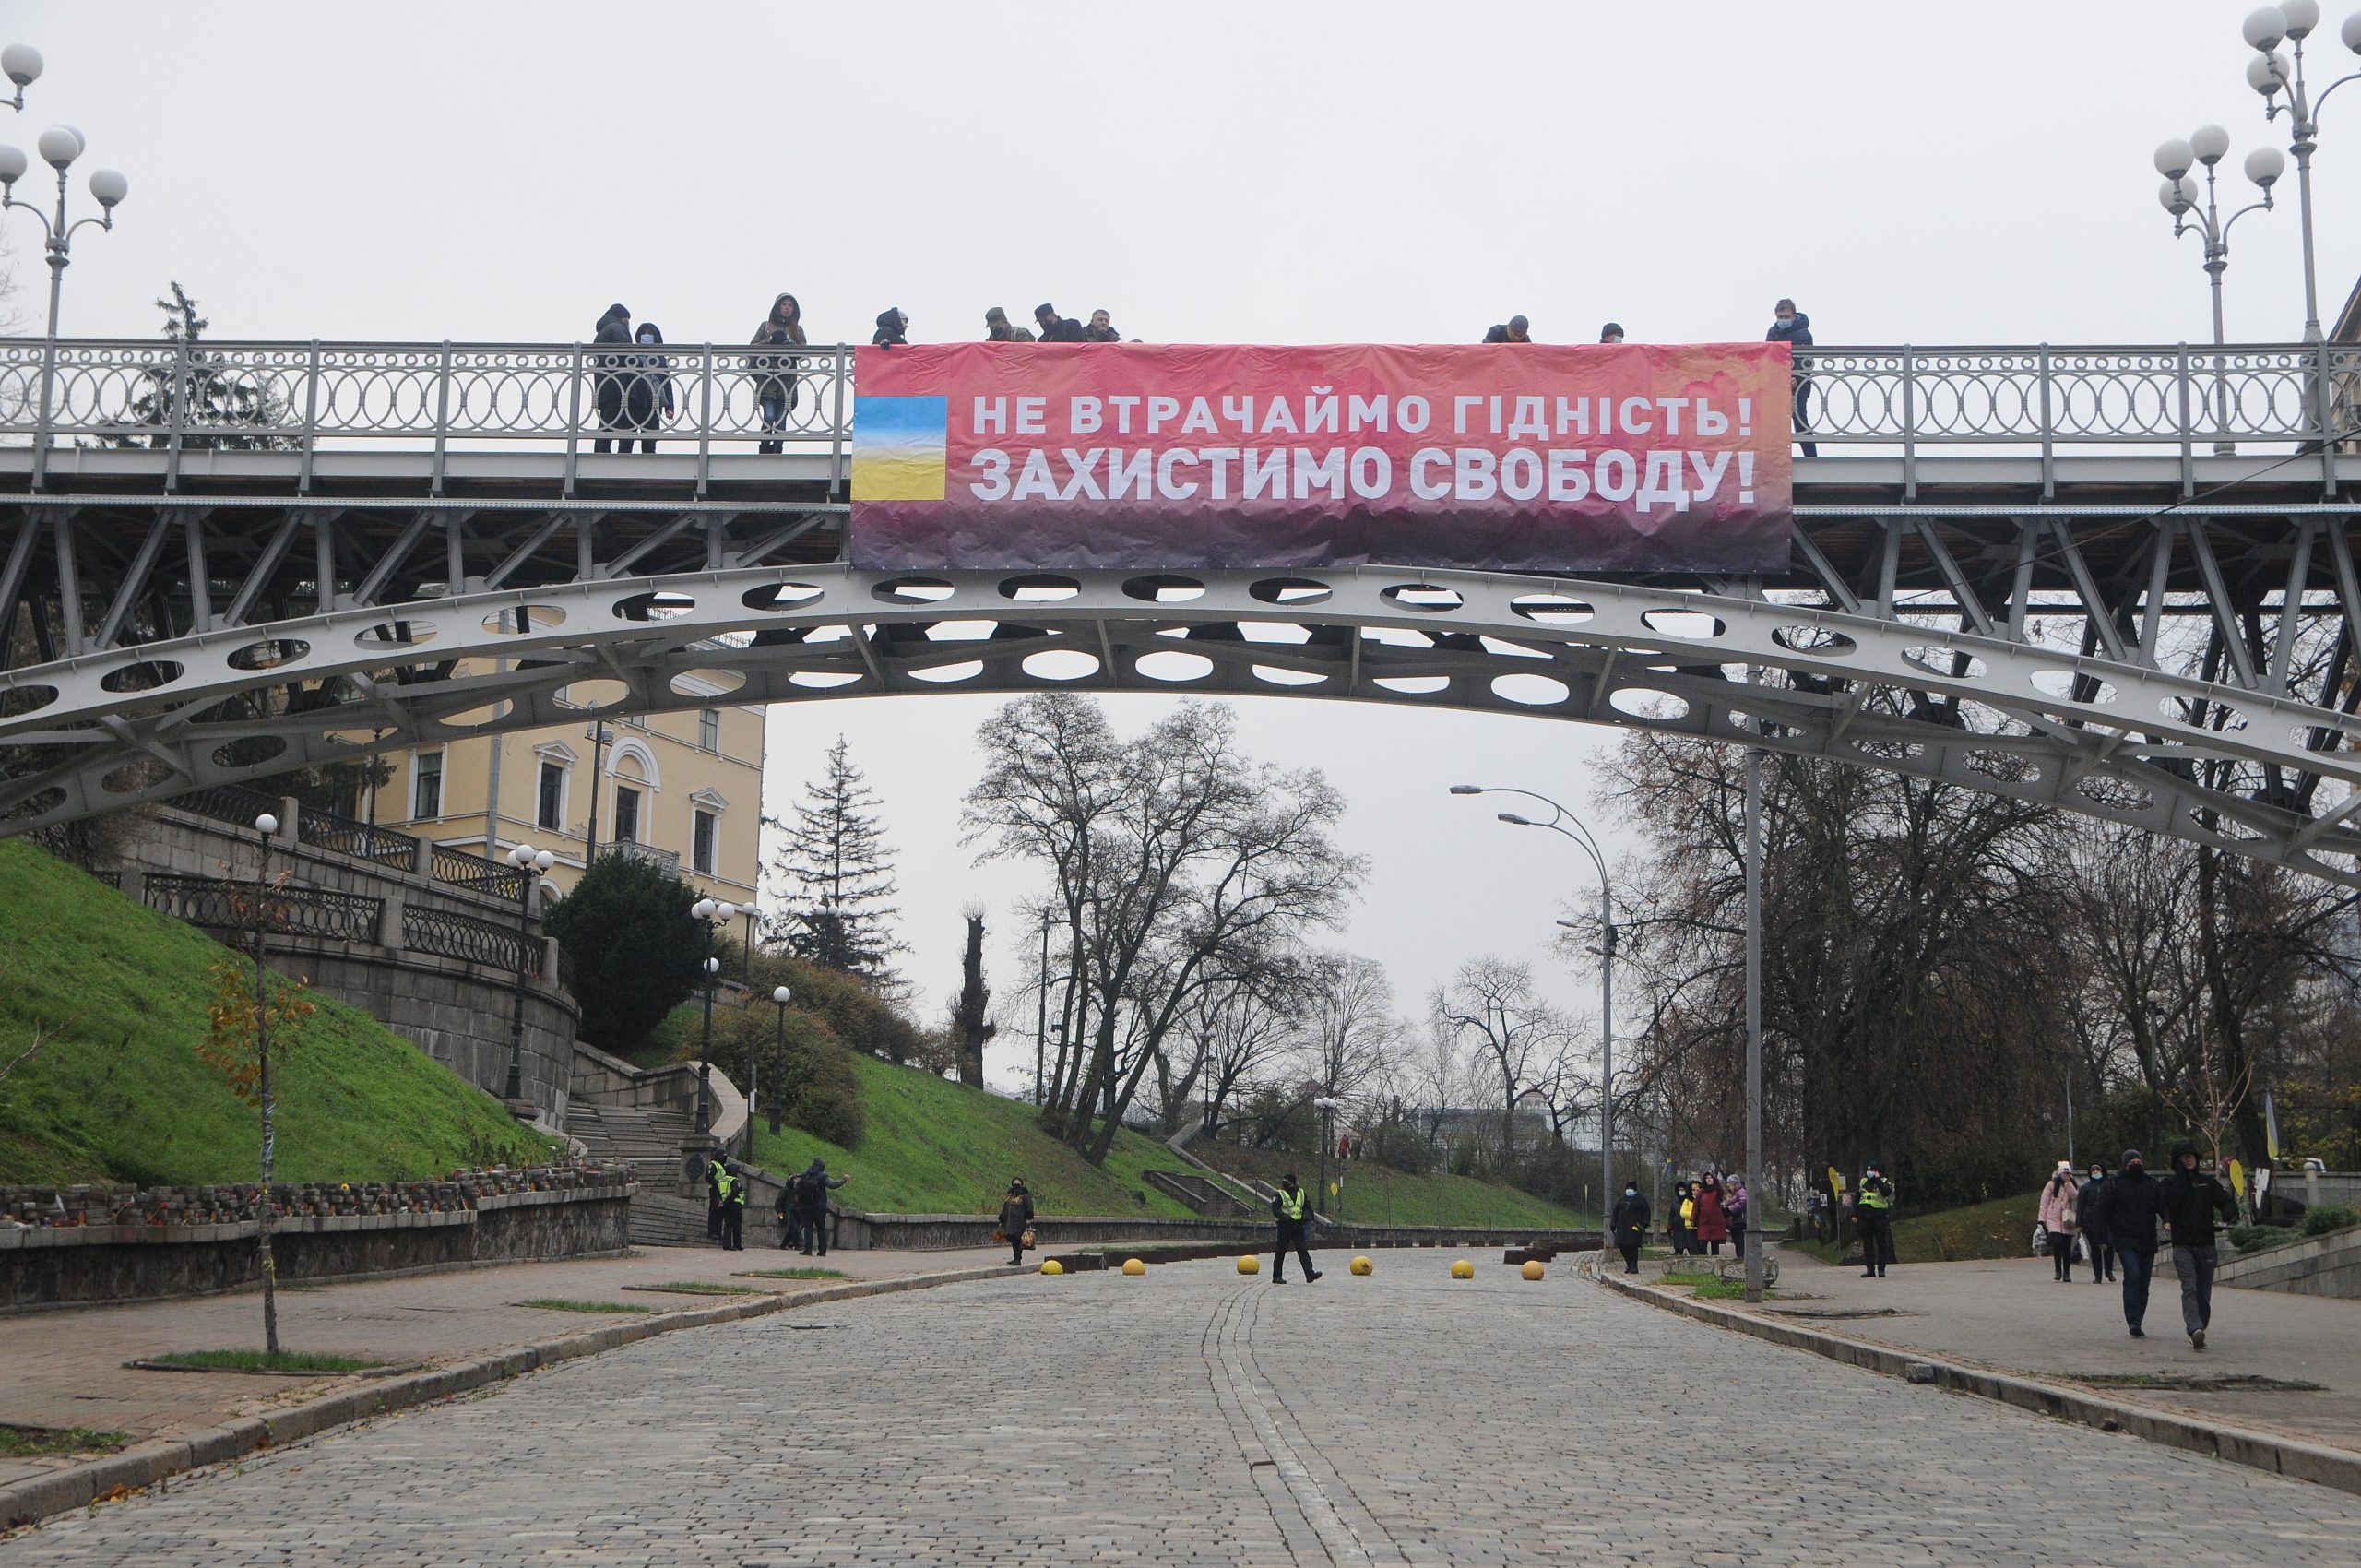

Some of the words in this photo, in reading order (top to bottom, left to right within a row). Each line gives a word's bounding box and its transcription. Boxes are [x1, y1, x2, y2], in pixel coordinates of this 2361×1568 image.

[973, 396, 1047, 434] НЕ
[1070, 385, 1430, 434] ВТРАЧАЙМО
[1454, 395, 1752, 441] ГІДНІСТЬ!
[969, 446, 1393, 501] ЗАХИСТИМО
[1409, 447, 1755, 513] СВОБОДУ!
